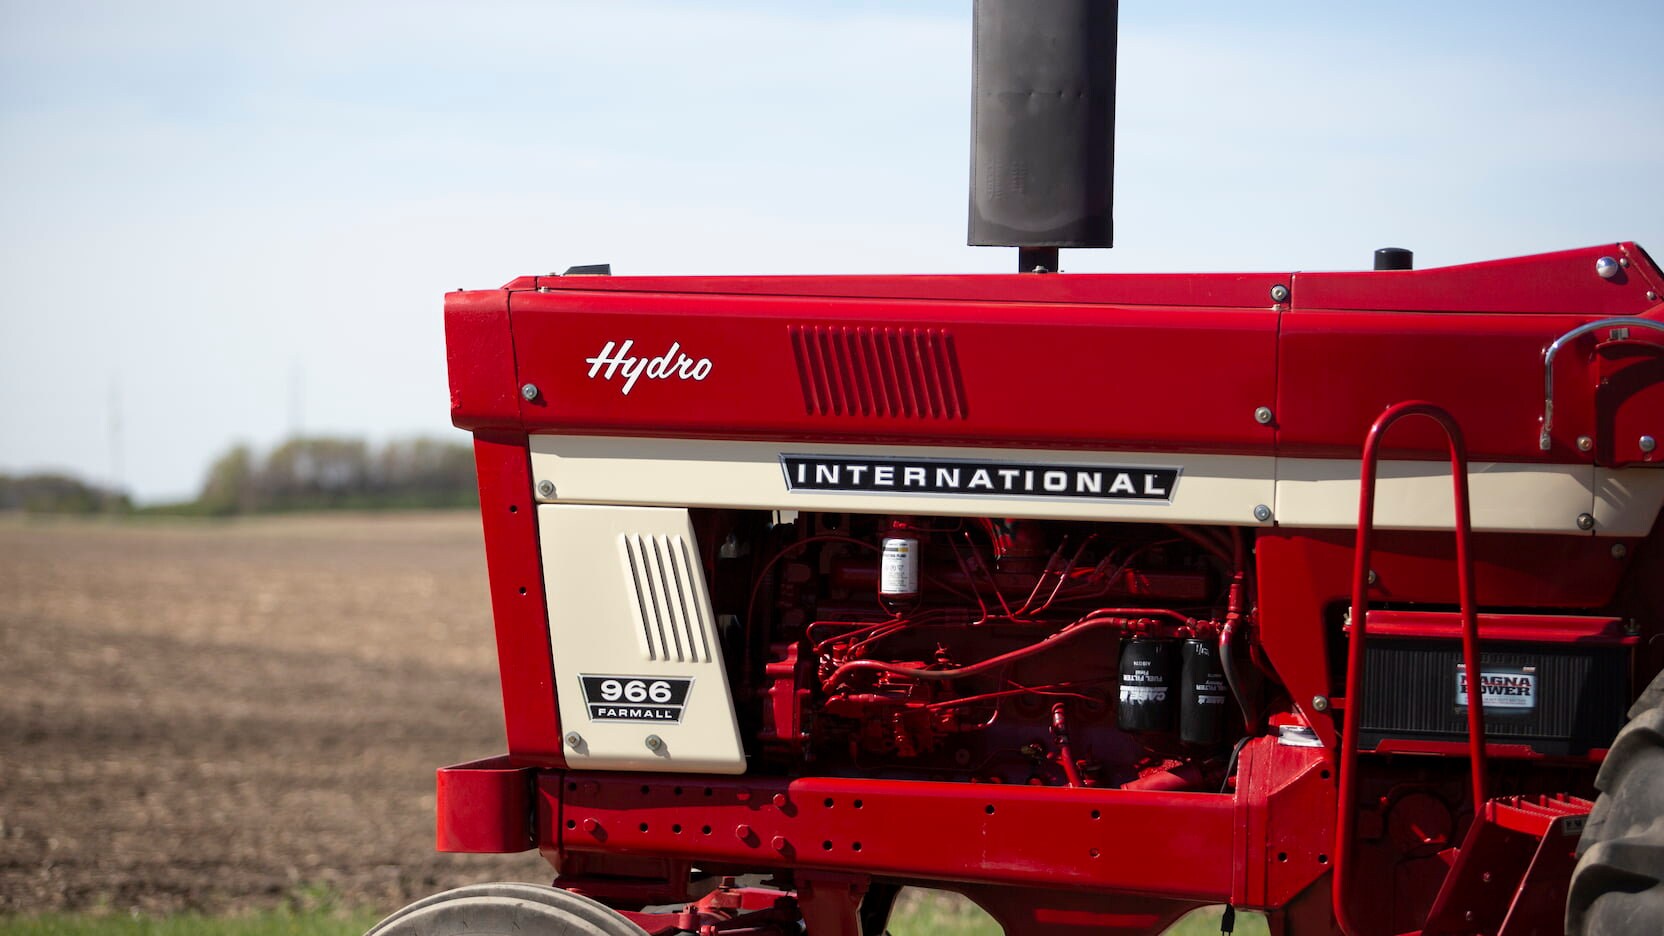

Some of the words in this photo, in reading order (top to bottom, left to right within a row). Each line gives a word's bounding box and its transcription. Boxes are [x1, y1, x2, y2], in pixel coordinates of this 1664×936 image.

[585, 339, 712, 396] Hydro
[797, 463, 1166, 495] INTERNATIONAL
[1123, 674, 1145, 682] FILTER
[601, 679, 672, 703] 966
[598, 708, 673, 719] FARMALL
